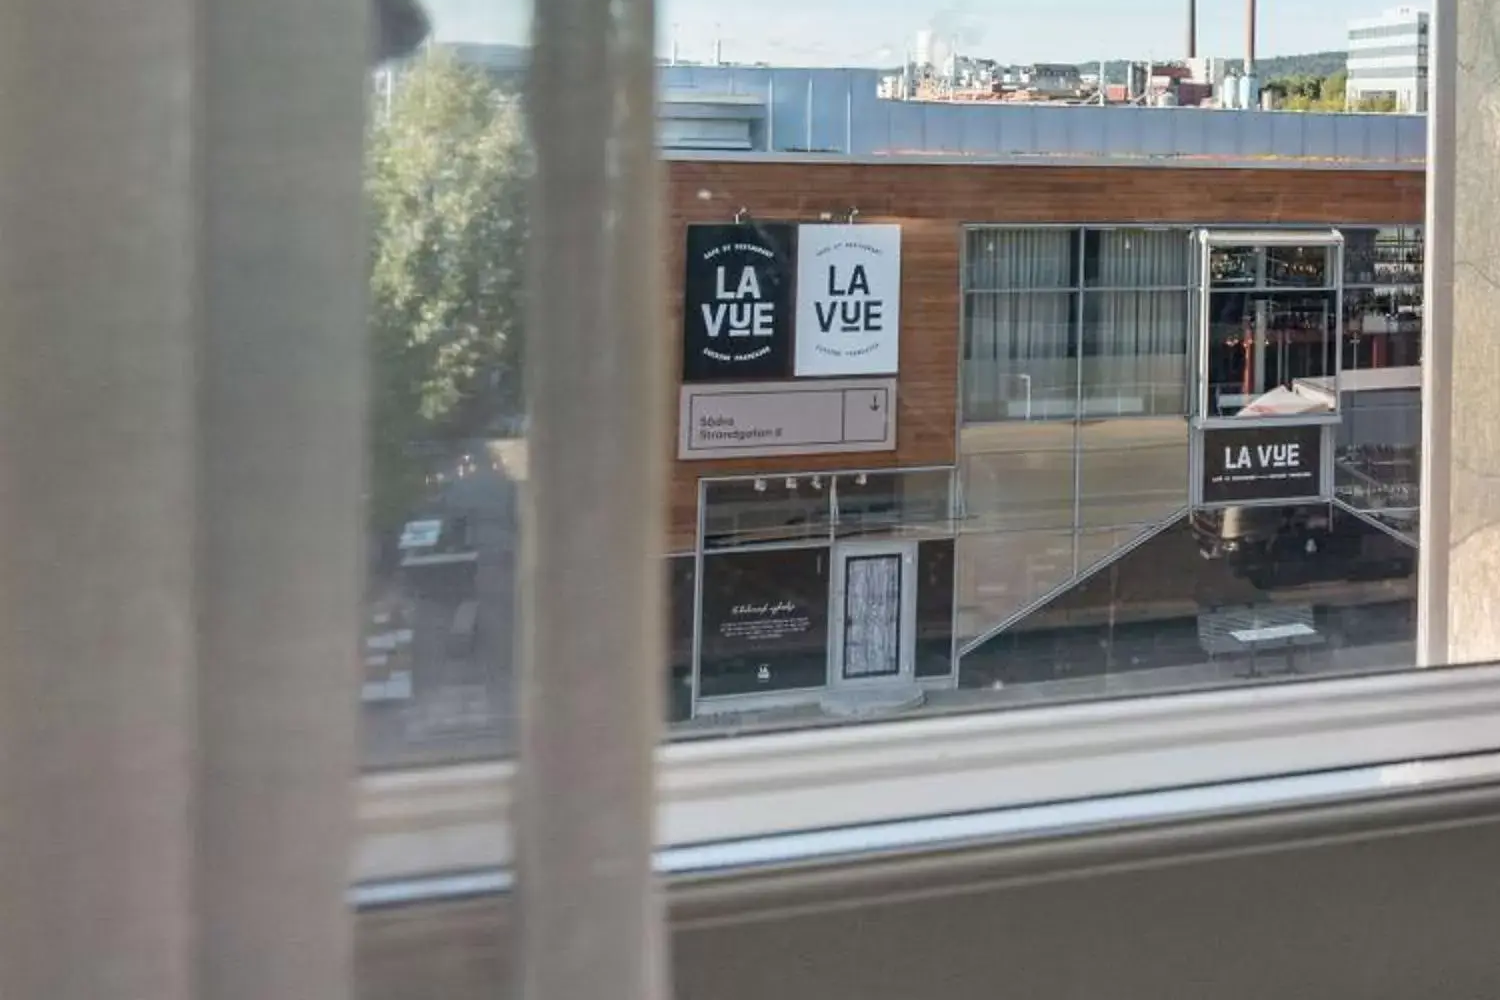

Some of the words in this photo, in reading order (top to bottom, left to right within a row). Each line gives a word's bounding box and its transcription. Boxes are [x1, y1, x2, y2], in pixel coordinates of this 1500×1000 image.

[715, 265, 761, 299] LA
[828, 264, 870, 297] LA
[701, 302, 775, 337] VUE
[814, 300, 883, 333] VUE
[1225, 446, 1252, 469] LA
[1257, 443, 1300, 468] VUE
